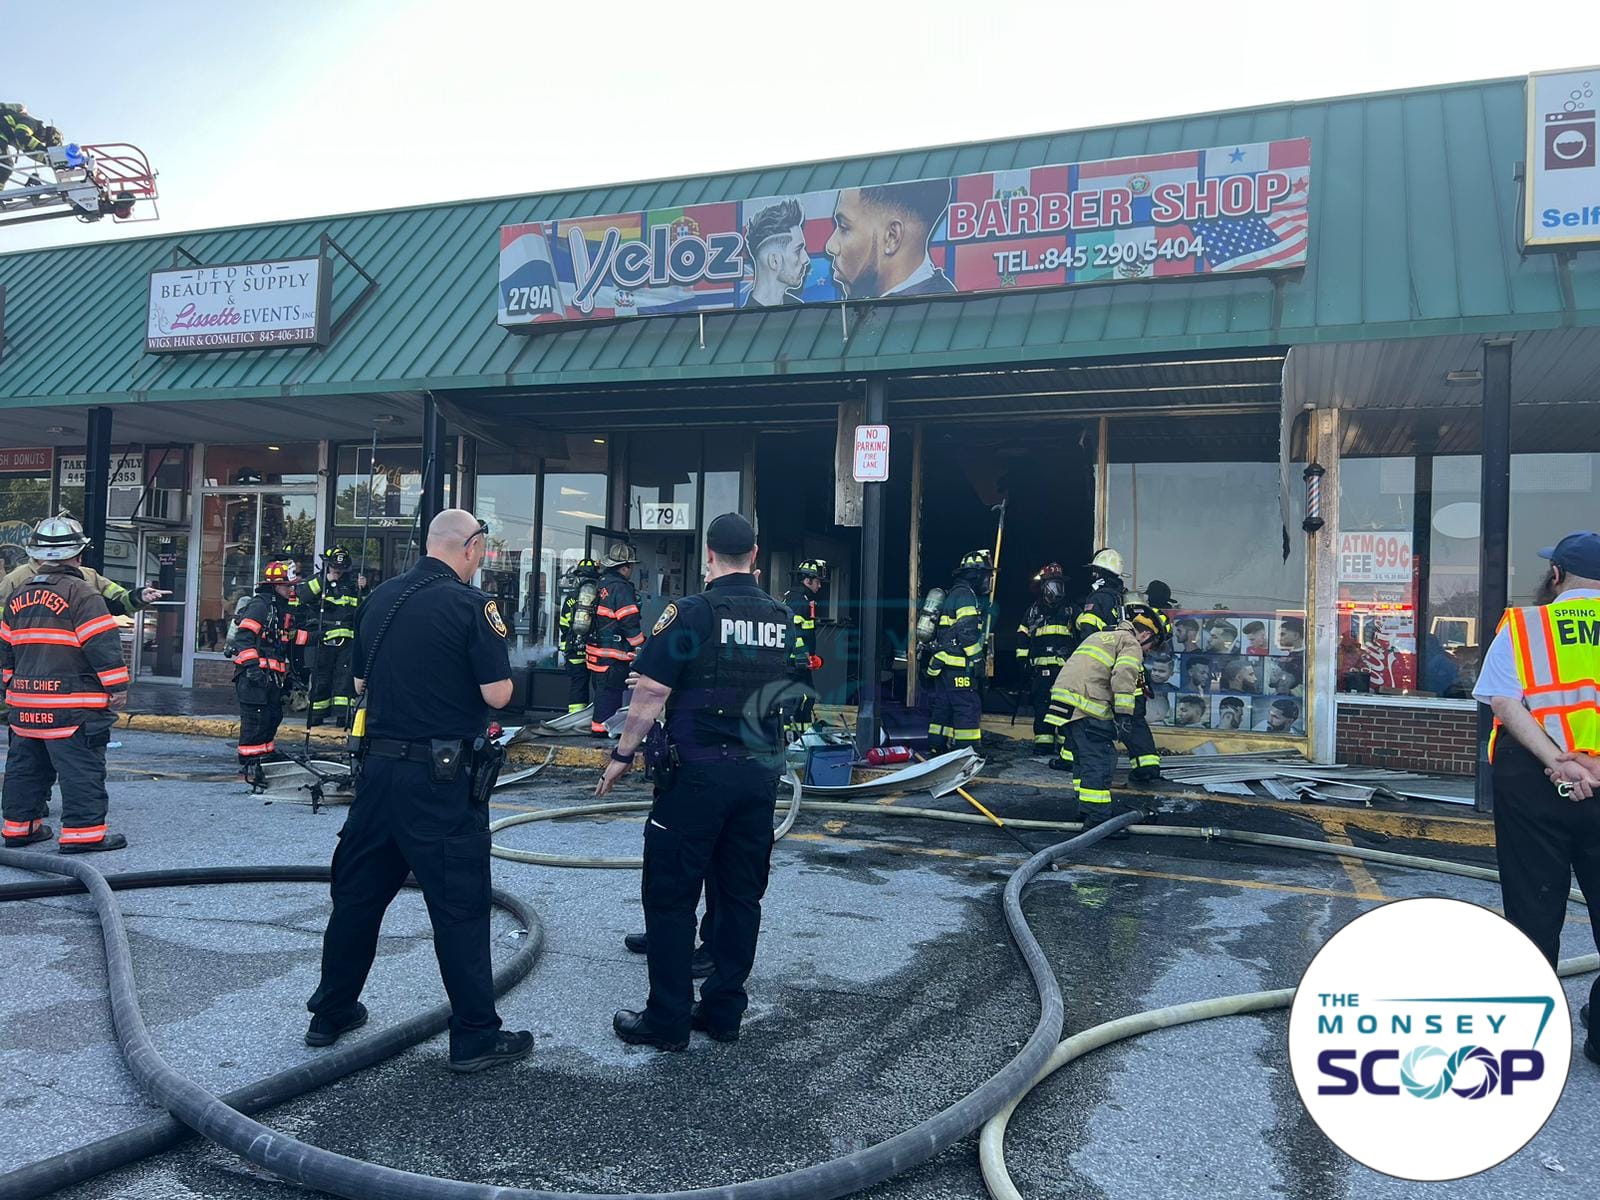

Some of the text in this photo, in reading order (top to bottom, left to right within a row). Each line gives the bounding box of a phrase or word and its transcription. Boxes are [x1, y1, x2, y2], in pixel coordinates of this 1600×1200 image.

[948, 171, 1293, 242] BARBER SHOP
[1541, 205, 1600, 228] Self
[1141, 236, 1204, 262] 5404
[197, 264, 272, 280] PEDRO
[568, 223, 745, 314] Veloz
[161, 272, 309, 299] BEAUTY SUPPLY
[226, 294, 236, 306] &
[507, 285, 554, 313] 279A
[170, 302, 242, 331] Lissette
[243, 305, 301, 325] EVENTS
[174, 334, 196, 346] HAIR
[197, 334, 205, 346] &
[205, 332, 255, 346] COSMETICS
[259, 327, 315, 341] 845-406-3113
[866, 430, 879, 440] NO
[856, 441, 887, 452] PARKING
[14, 452, 45, 465] DONUTS
[862, 460, 878, 469] LANE
[645, 507, 685, 525] 279A
[1342, 534, 1374, 553] ATM
[1342, 554, 1372, 573] FEE
[9, 590, 69, 615] HILLCREST
[1554, 609, 1596, 617] SPRING
[720, 618, 787, 649] POLICE
[33, 680, 61, 691] CHIEF
[954, 677, 971, 687] 196
[19, 711, 54, 724] BOWERS
